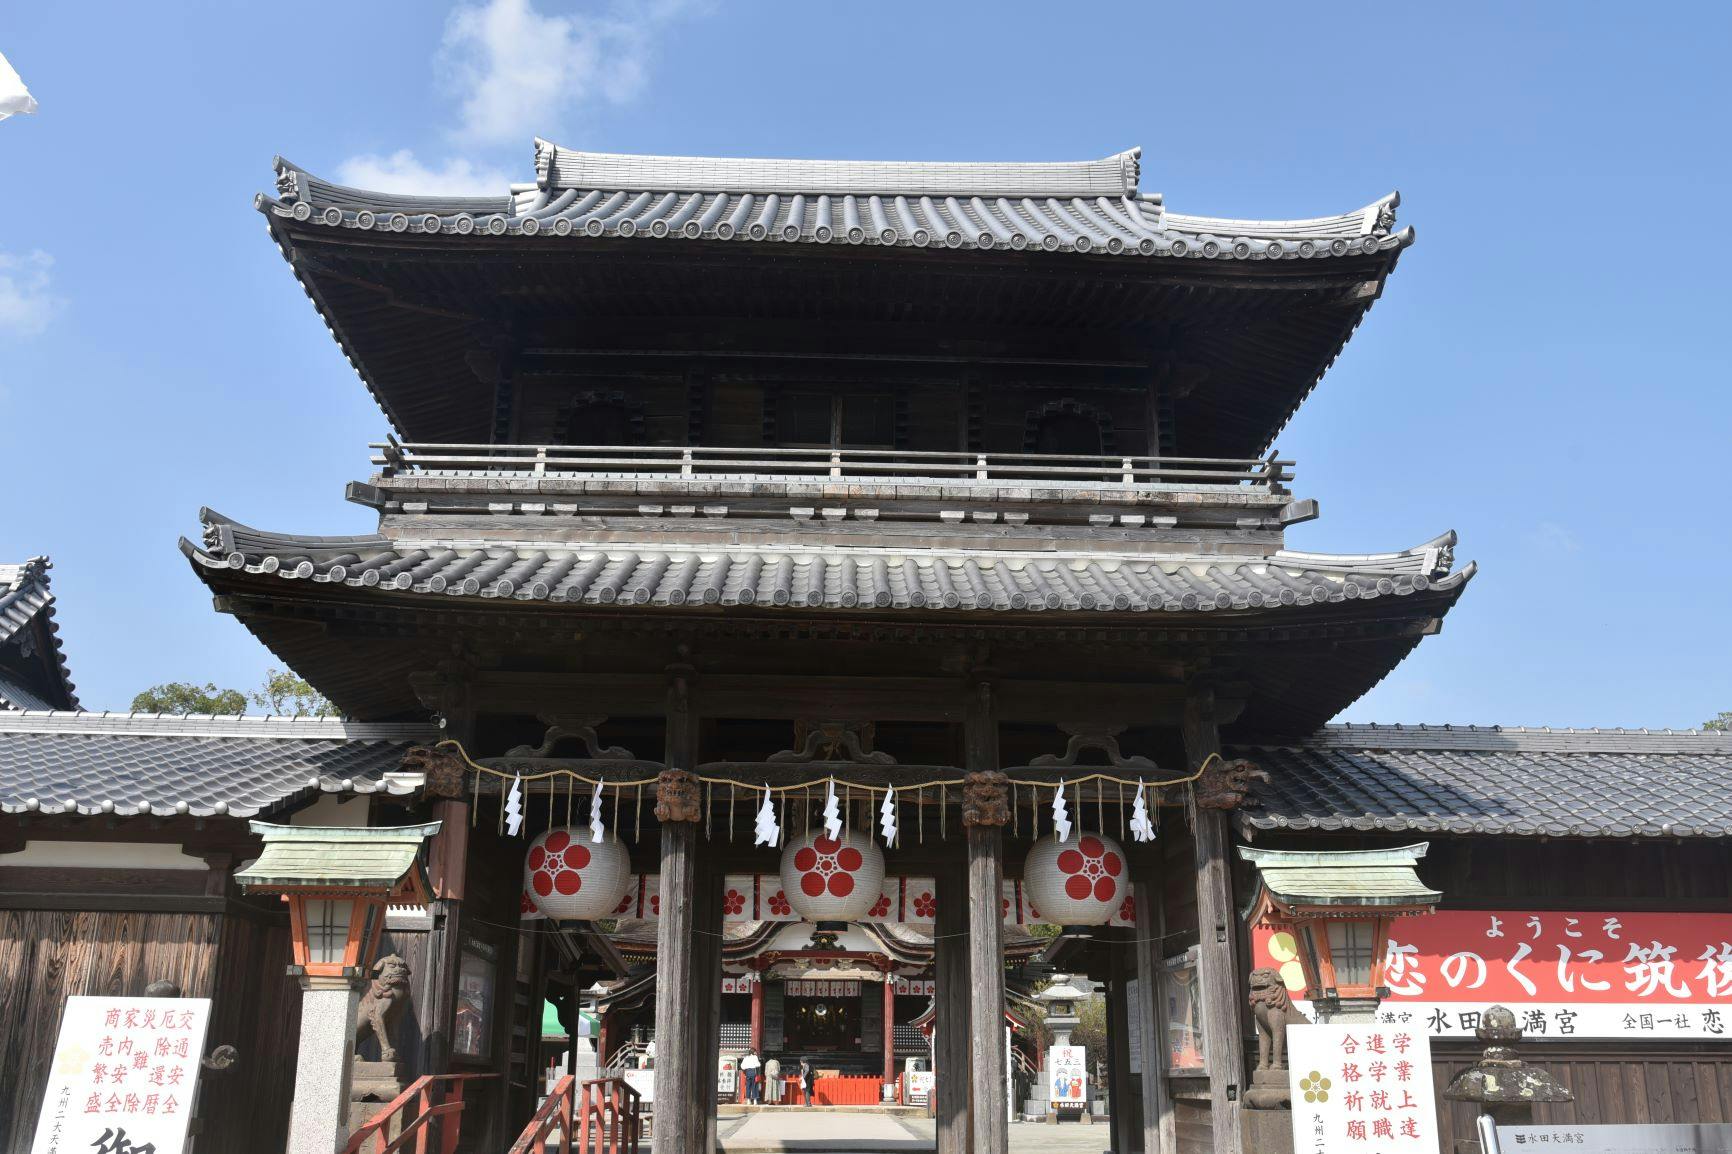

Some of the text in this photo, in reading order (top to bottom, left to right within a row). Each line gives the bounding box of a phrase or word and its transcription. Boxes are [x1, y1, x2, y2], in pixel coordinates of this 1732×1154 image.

[1486, 916, 1622, 939] ようこそ
[84, 1008, 121, 1114] 商売繁盛
[104, 1008, 141, 1113] 家内安全
[142, 1009, 176, 1115] 厄除還暦
[162, 1009, 194, 1114] 交通安全
[1426, 1007, 1578, 1034] 水田満宮
[1621, 1012, 1691, 1031] 全国一社
[1702, 1008, 1724, 1034] 恋
[1340, 1033, 1367, 1140] 合格祈願
[1366, 1033, 1394, 1140] 進学就職
[1392, 1033, 1421, 1139] 学業上達
[1528, 1132, 1584, 1144] 水田天満宮
